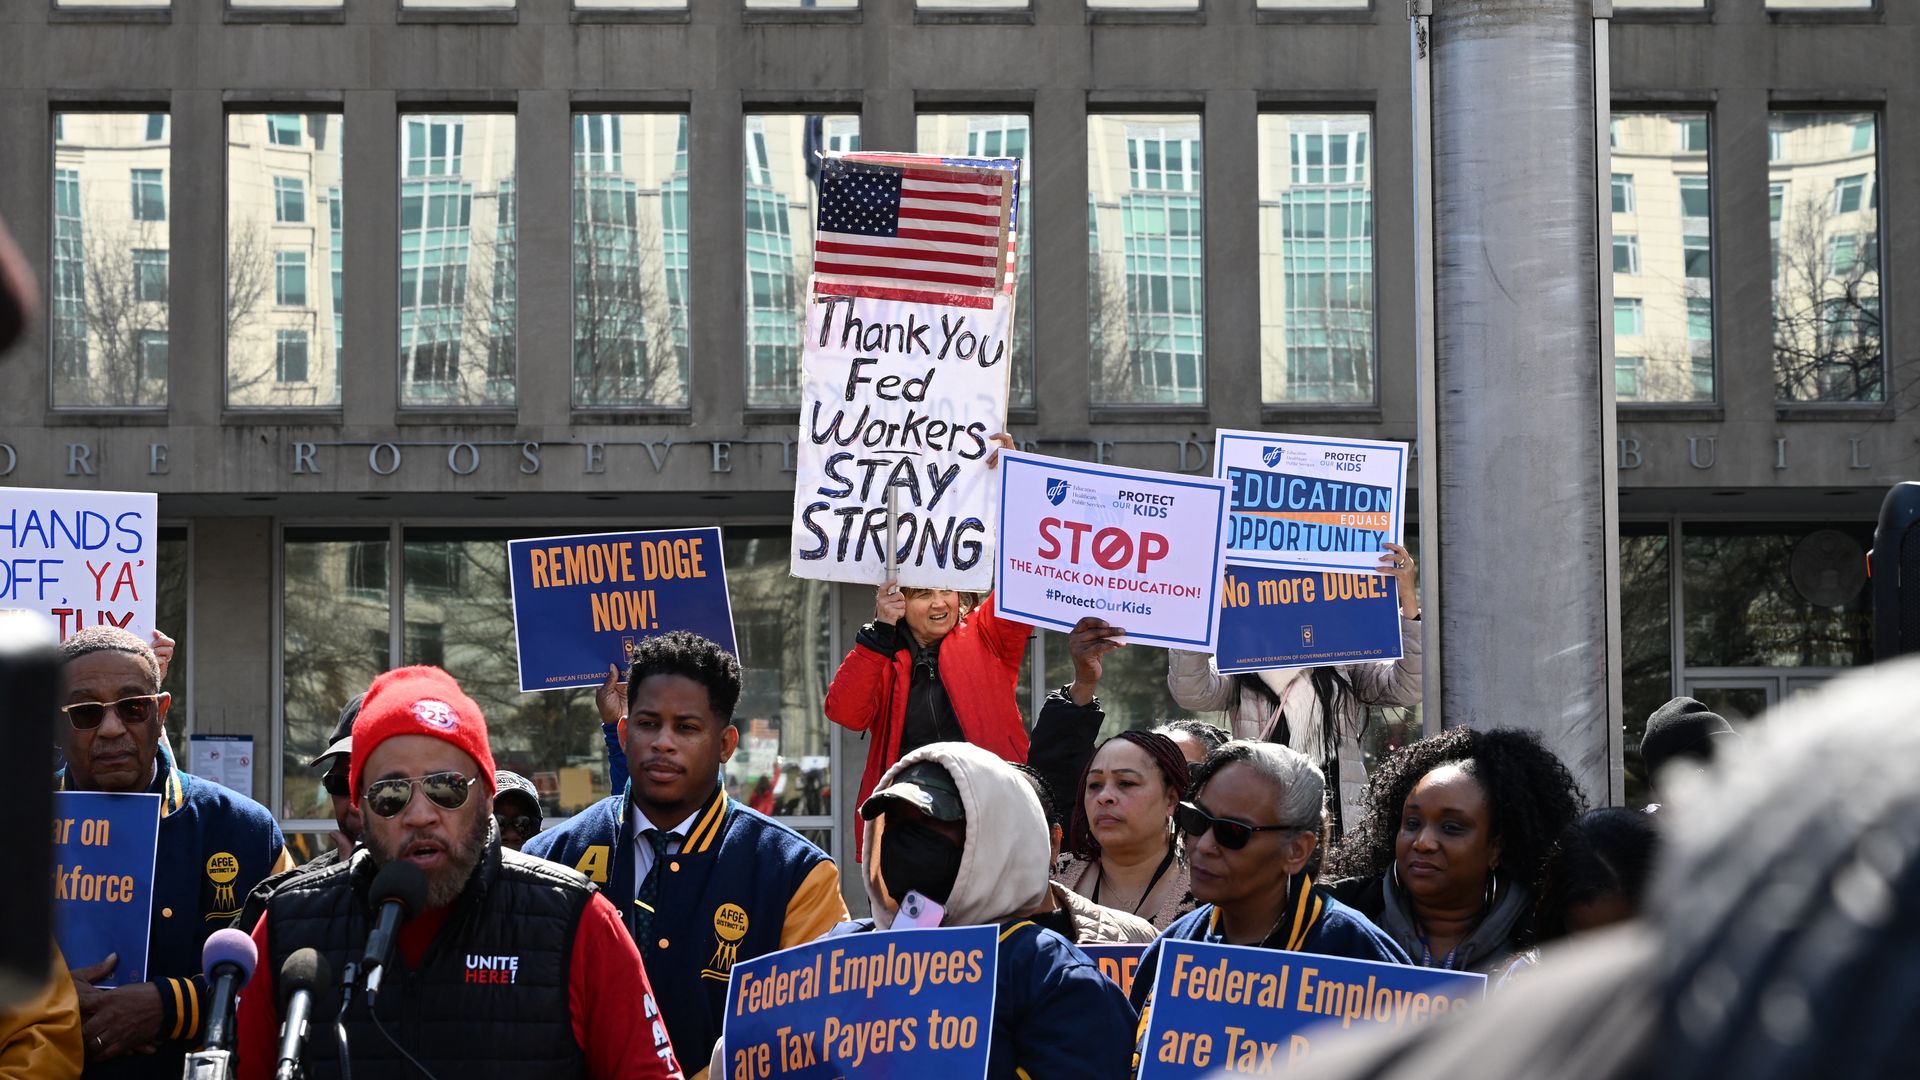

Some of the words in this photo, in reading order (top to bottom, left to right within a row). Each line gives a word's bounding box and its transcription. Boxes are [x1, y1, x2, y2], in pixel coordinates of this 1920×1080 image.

[813, 296, 930, 354] Thank
[937, 313, 1003, 368] You
[845, 357, 935, 402] Fed
[812, 400, 987, 460] Workers
[1325, 452, 1366, 463] PROTECT
[1336, 462, 1361, 472] KIDS
[817, 452, 961, 512] STAY
[1047, 480, 1068, 500] aft
[1118, 490, 1175, 506] PROTECT
[1227, 471, 1391, 512] EDUCATION
[1113, 501, 1131, 509] OUR
[1133, 504, 1167, 518] KIDS
[1340, 514, 1388, 526] EQUALS
[800, 501, 985, 571] STRONG
[1038, 516, 1169, 574] STOP
[530, 542, 635, 588] REMOVE
[640, 538, 707, 581] DOGE
[1010, 558, 1032, 573] THE
[1034, 565, 1080, 583] ATTACK
[1082, 574, 1104, 587] ON
[1108, 577, 1201, 598] EDUCATION!
[1046, 588, 1152, 615] #ProtectOurKids
[1222, 575, 1249, 608] No
[1258, 577, 1315, 606] more
[1322, 572, 1388, 601] DOGE!
[591, 589, 659, 632] NOW!
[1300, 652, 1334, 660] GOVERNMENT
[545, 675, 576, 683] AMERICAN
[577, 672, 609, 680] FEDERATIO
[428, 710, 448, 724] 25
[51, 818, 74, 845] ar
[81, 818, 110, 846] on
[211, 857, 233, 867] AFGE
[54, 864, 134, 903] kforce
[716, 919, 738, 930] DISTRICT
[720, 907, 744, 924] AFGE
[465, 969, 517, 984] HERE!
[466, 954, 519, 970] UNITE
[737, 953, 822, 1016] Federal
[828, 943, 983, 999] Employees
[1170, 954, 1290, 1009] Federal
[735, 1042, 770, 1080] are
[776, 1026, 816, 1073] Tax
[823, 1016, 918, 1068] Payers
[928, 1009, 978, 1050] too
[1158, 1029, 1213, 1067] are
[1224, 1026, 1278, 1075] Tax
